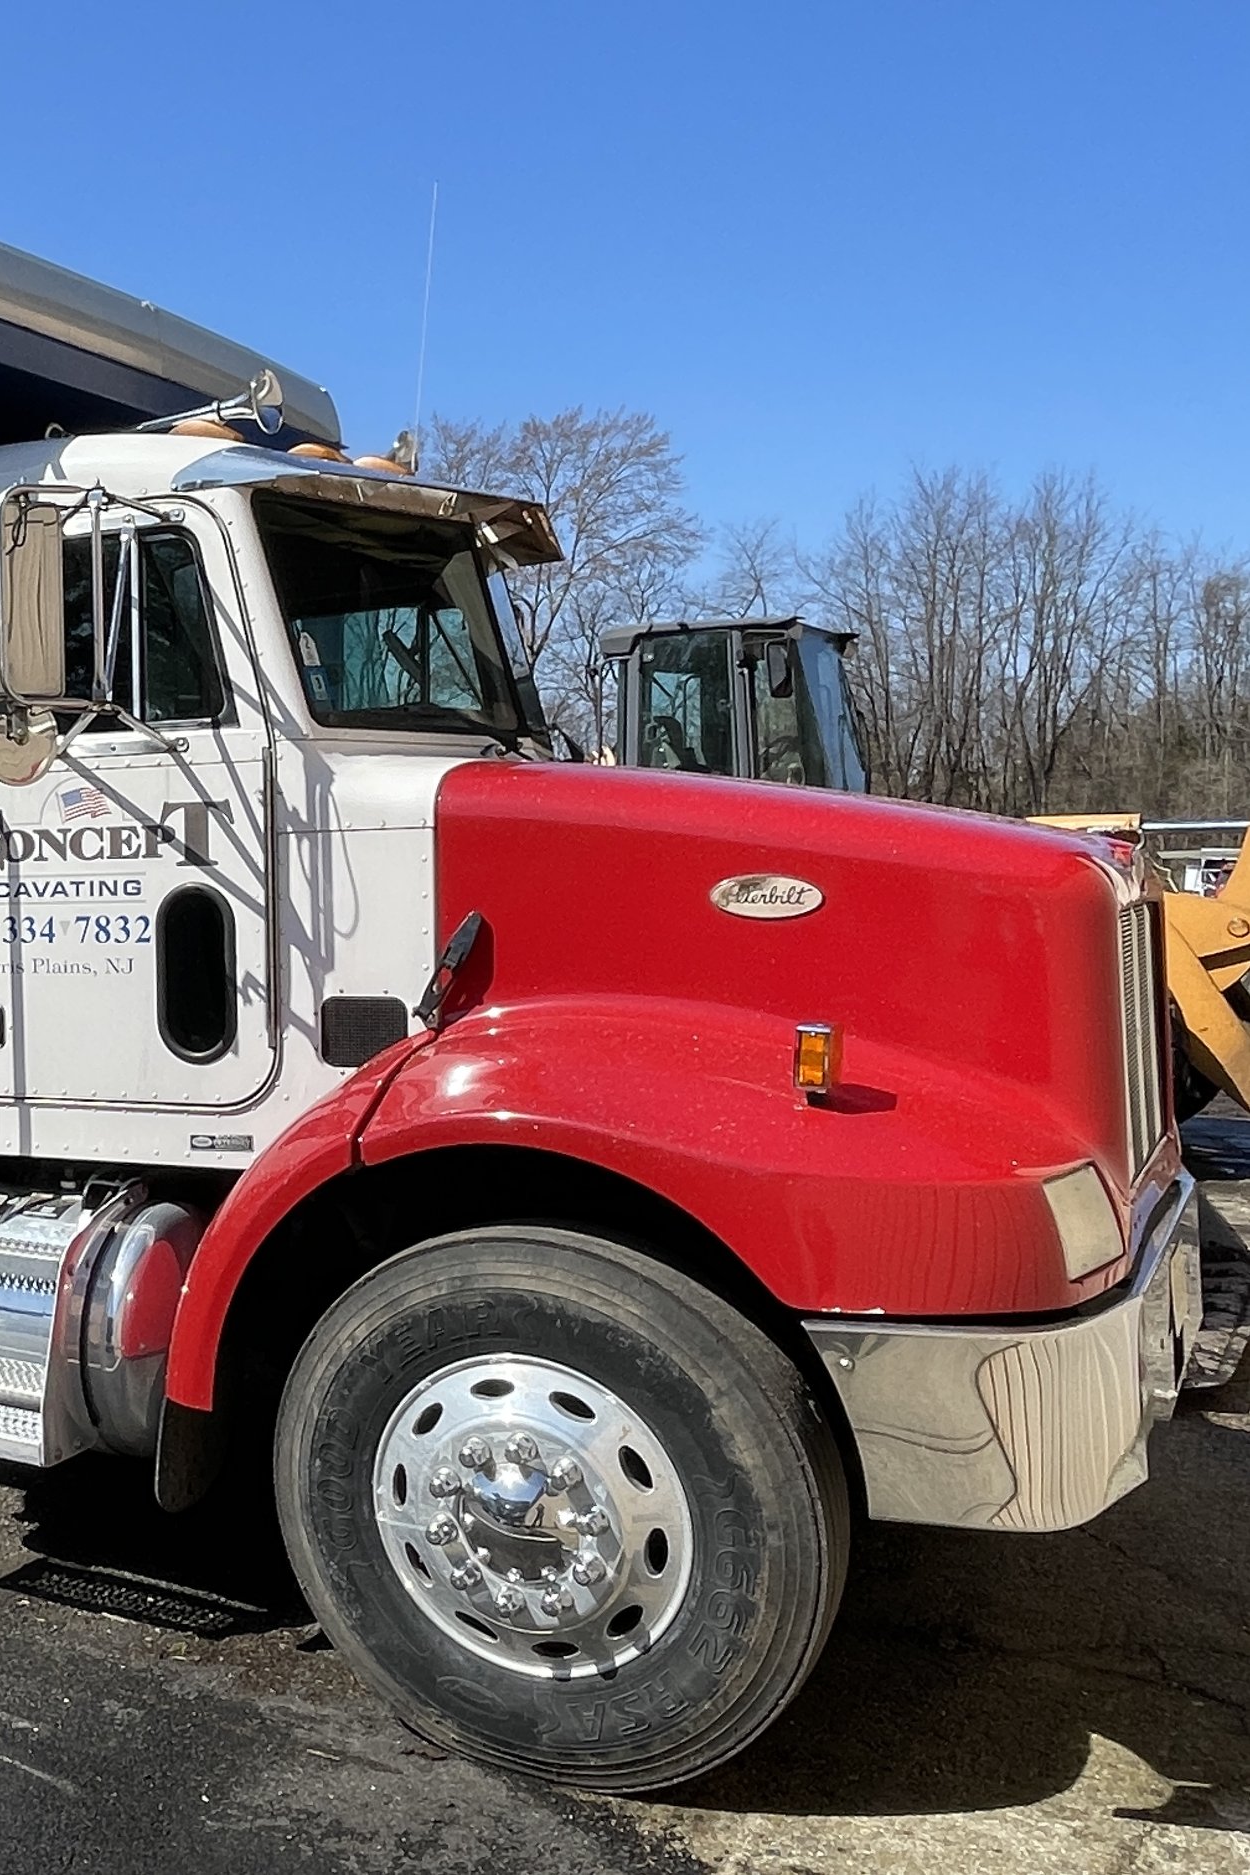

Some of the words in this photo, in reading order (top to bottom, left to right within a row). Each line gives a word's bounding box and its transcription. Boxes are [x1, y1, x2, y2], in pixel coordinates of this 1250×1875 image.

[2, 915, 56, 944] 334
[73, 914, 153, 944] 7832
[31, 957, 99, 977] Plains,
[103, 957, 136, 975] NJ
